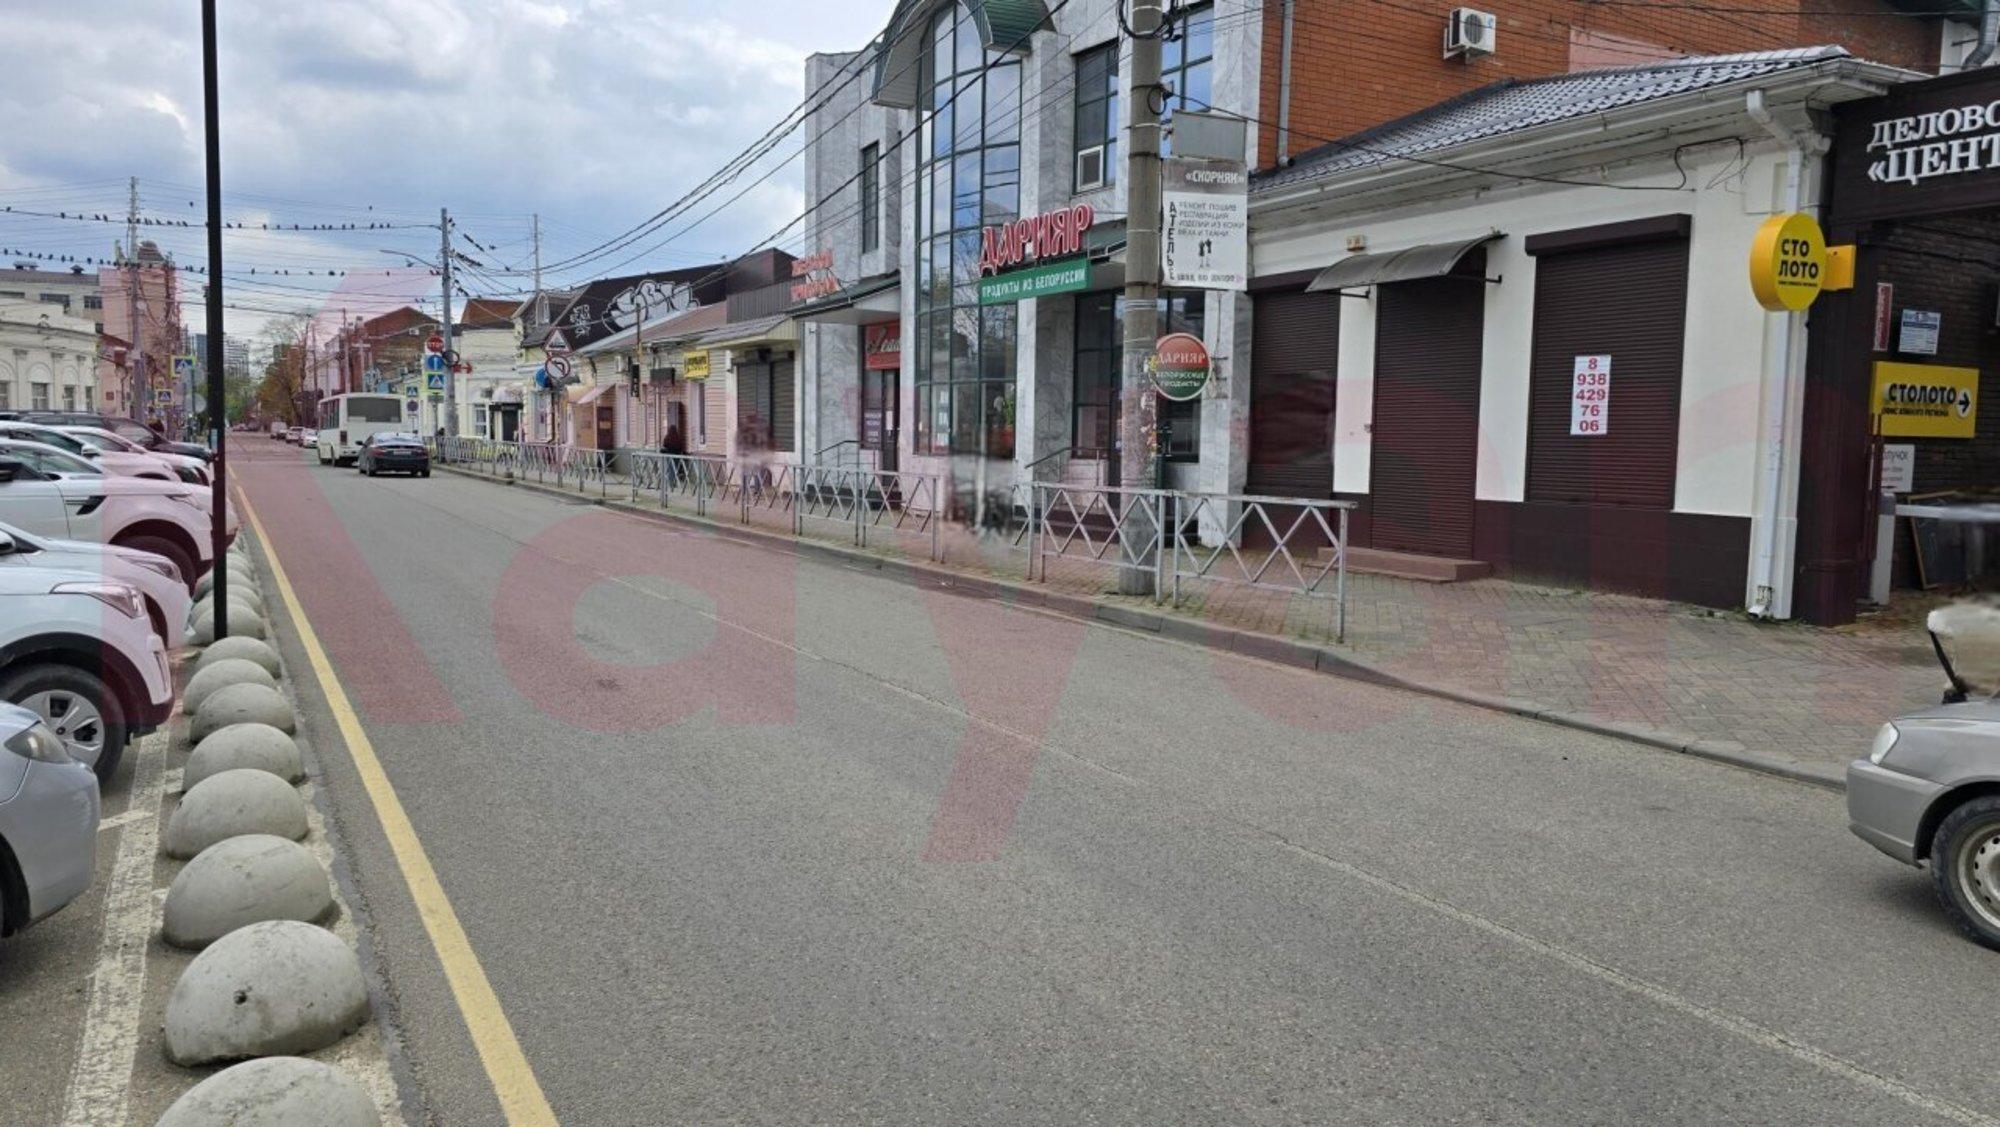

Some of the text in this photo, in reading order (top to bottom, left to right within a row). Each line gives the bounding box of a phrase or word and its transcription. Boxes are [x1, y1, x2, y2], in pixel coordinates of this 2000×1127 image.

[978, 203, 1094, 278] ДАРИЯР
[1781, 239, 1810, 257] СТО
[1778, 260, 1819, 279] ЛОТО
[981, 268, 1086, 298] ПРОДУКТЫ ИЗ БЕЛОРУССИИ
[1157, 351, 1206, 364] ДАРИЯР
[1588, 357, 1598, 370] 8
[1577, 373, 1607, 386] 938
[1576, 388, 1606, 401] 429
[1888, 382, 1957, 404] СТОЛОТО
[1580, 404, 1601, 417] 76
[1579, 419, 1600, 432] 06
